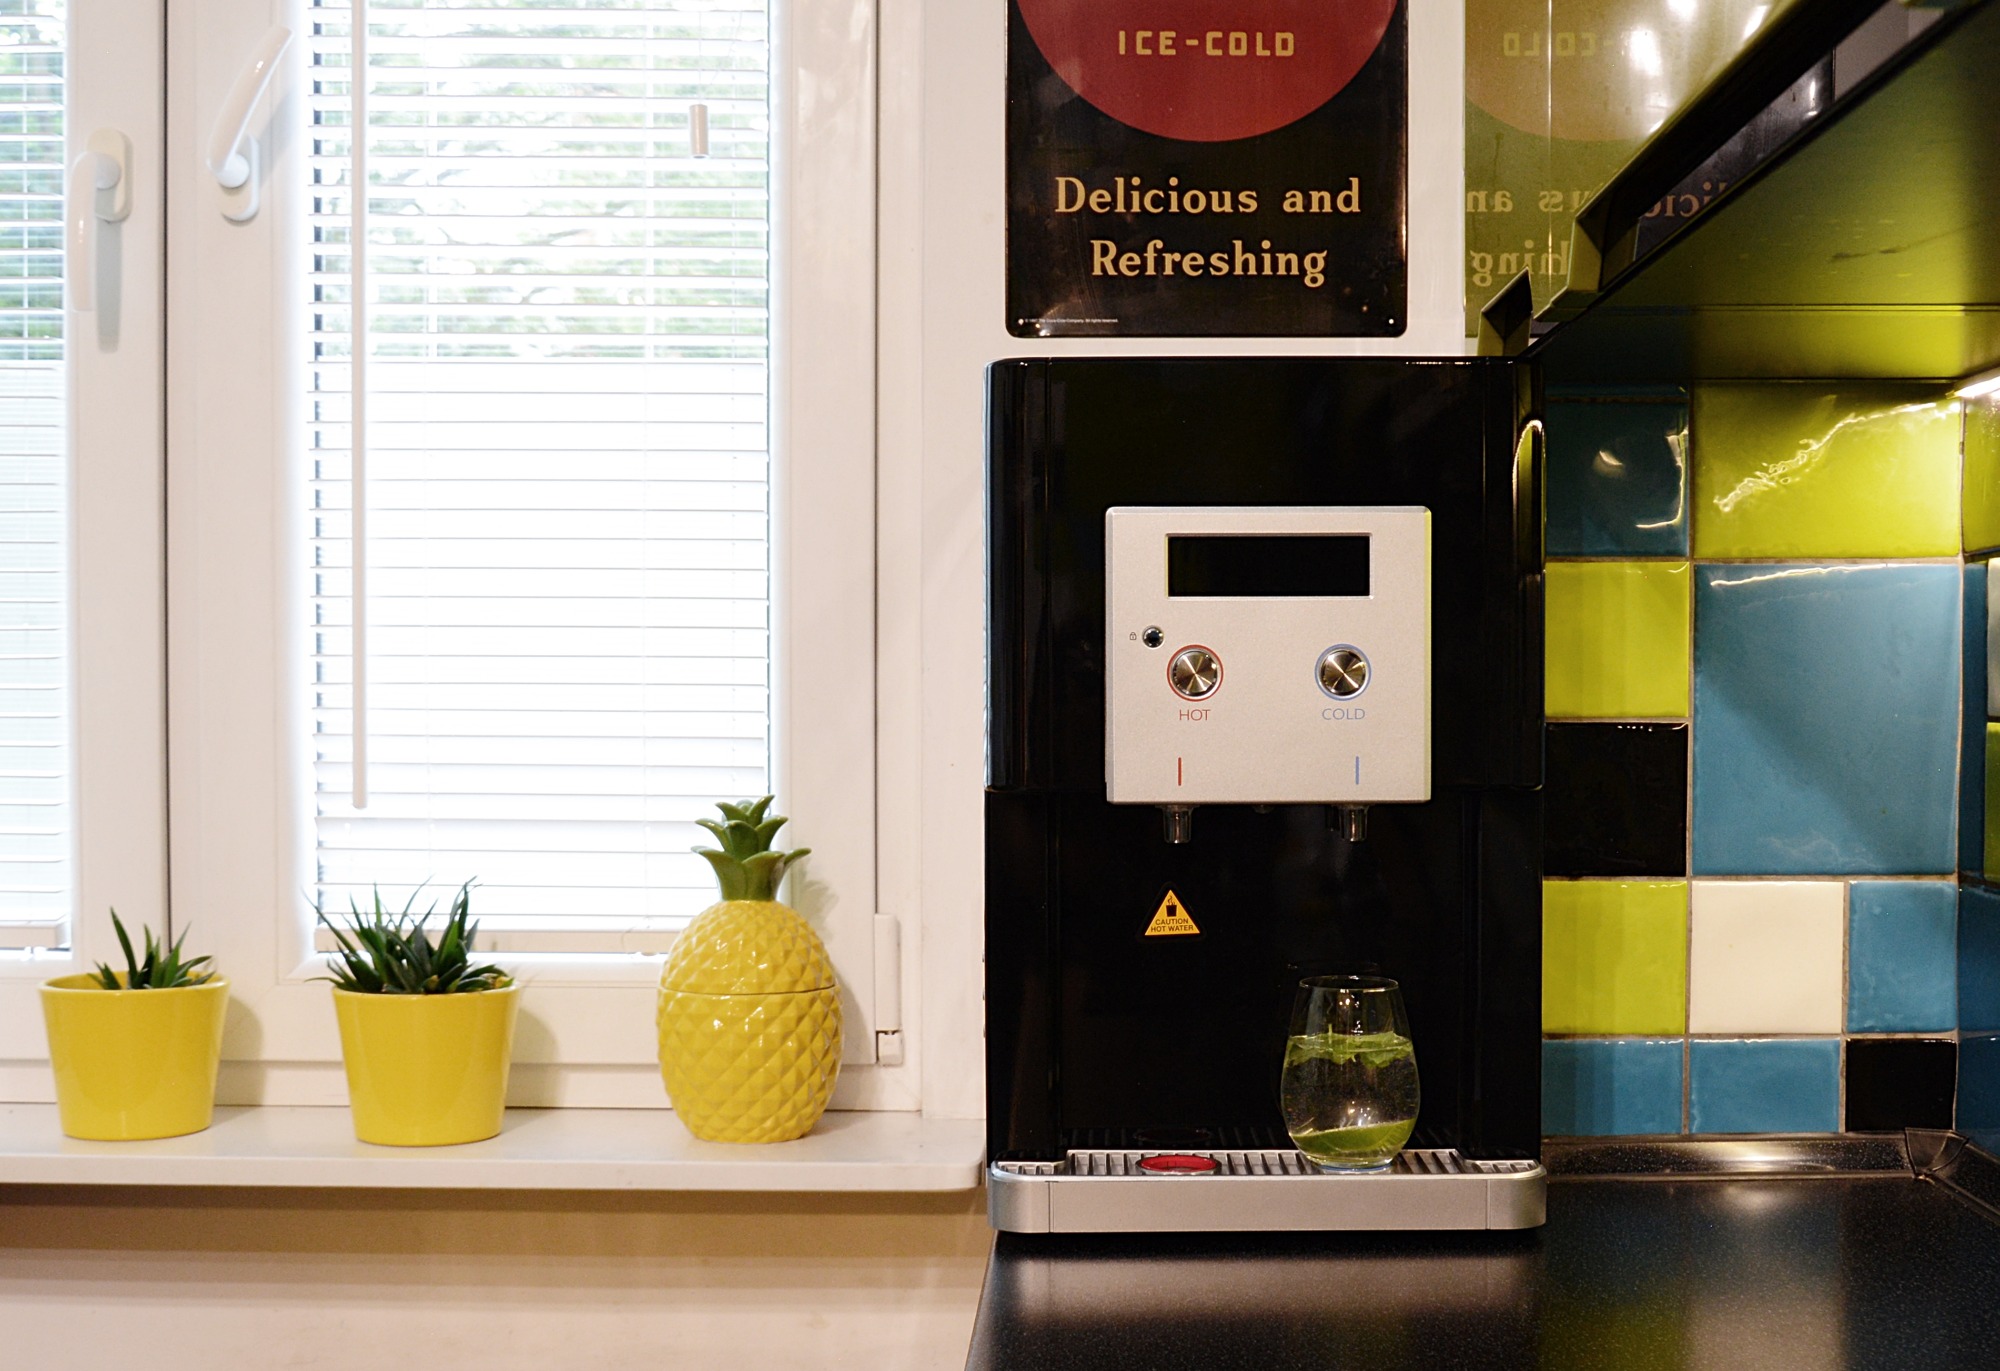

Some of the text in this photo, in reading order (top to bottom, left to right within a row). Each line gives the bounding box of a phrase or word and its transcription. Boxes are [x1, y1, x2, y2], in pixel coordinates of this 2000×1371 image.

[1118, 30, 1295, 57] ICE-COLD
[1054, 176, 1361, 214] Delicious and
[1090, 239, 1328, 288] Refreshing
[1178, 709, 1211, 722] HOT
[1321, 708, 1366, 721] COLD
[1150, 924, 1194, 933] HOT WATER
[1155, 918, 1189, 926] CAUTION
